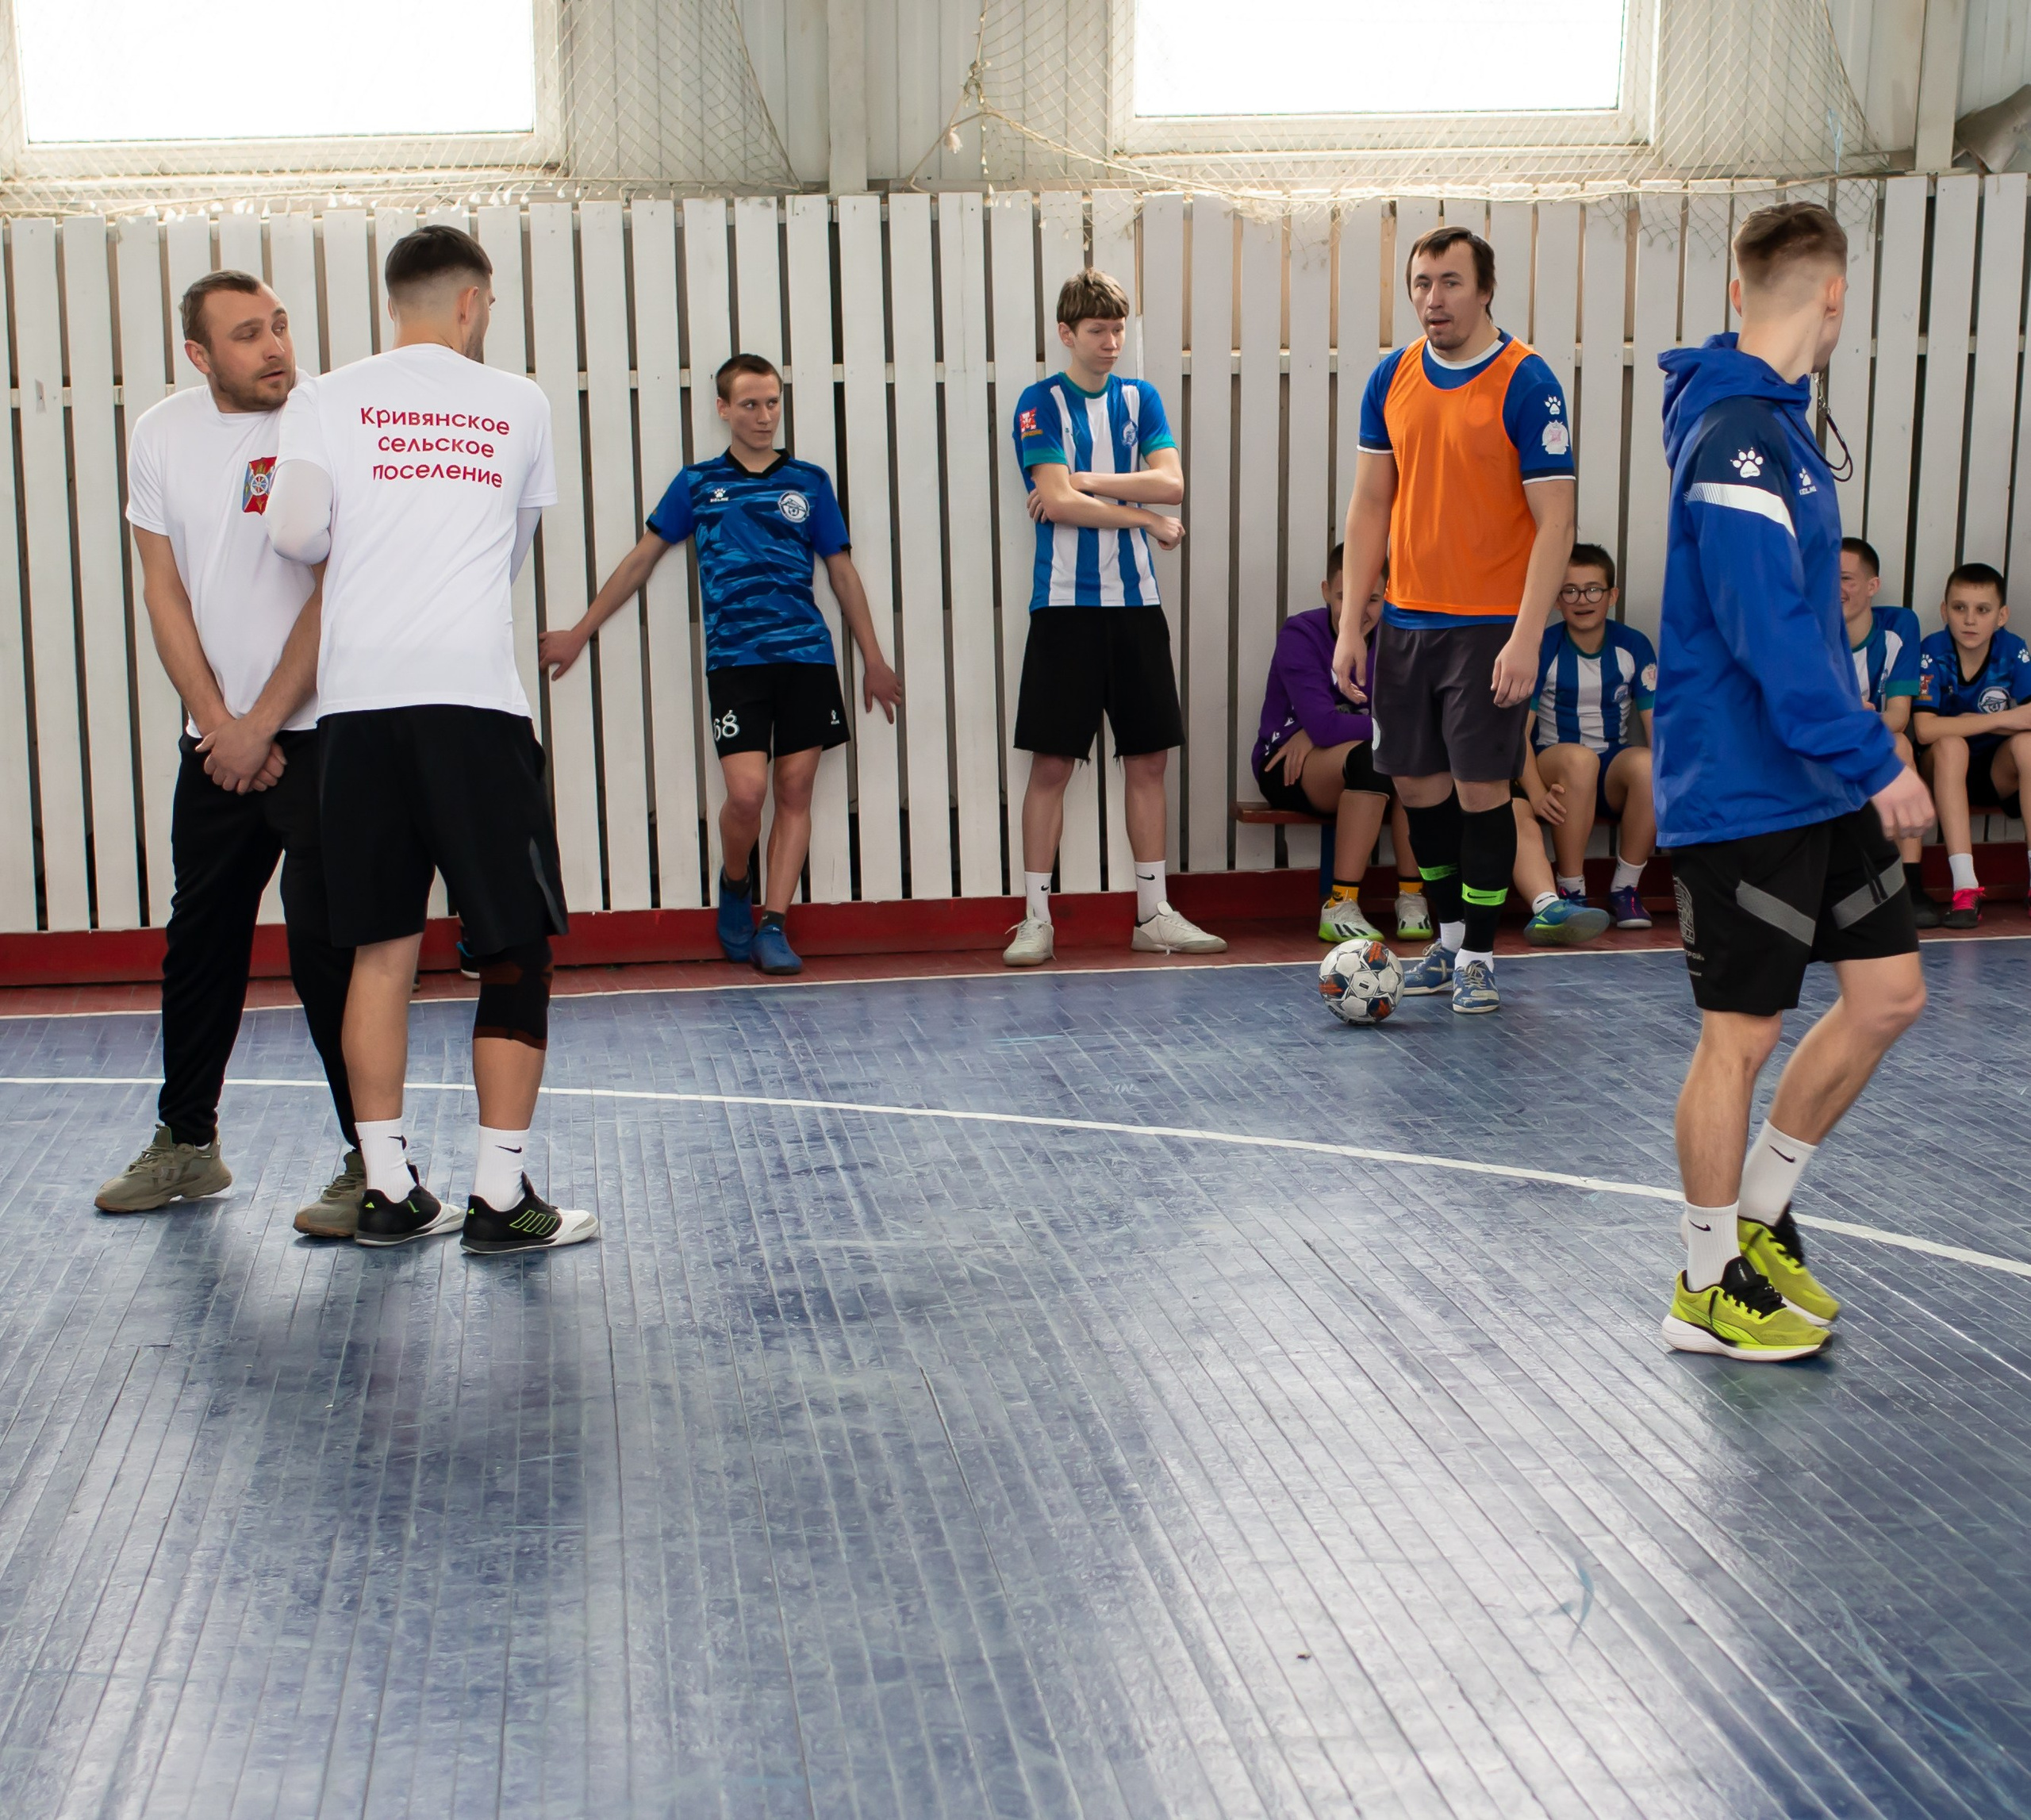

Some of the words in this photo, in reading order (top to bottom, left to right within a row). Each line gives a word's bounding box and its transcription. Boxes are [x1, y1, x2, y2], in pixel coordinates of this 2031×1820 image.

[360, 406, 510, 436] Кривянское
[378, 436, 494, 458] сельское
[373, 463, 502, 488] поселение
